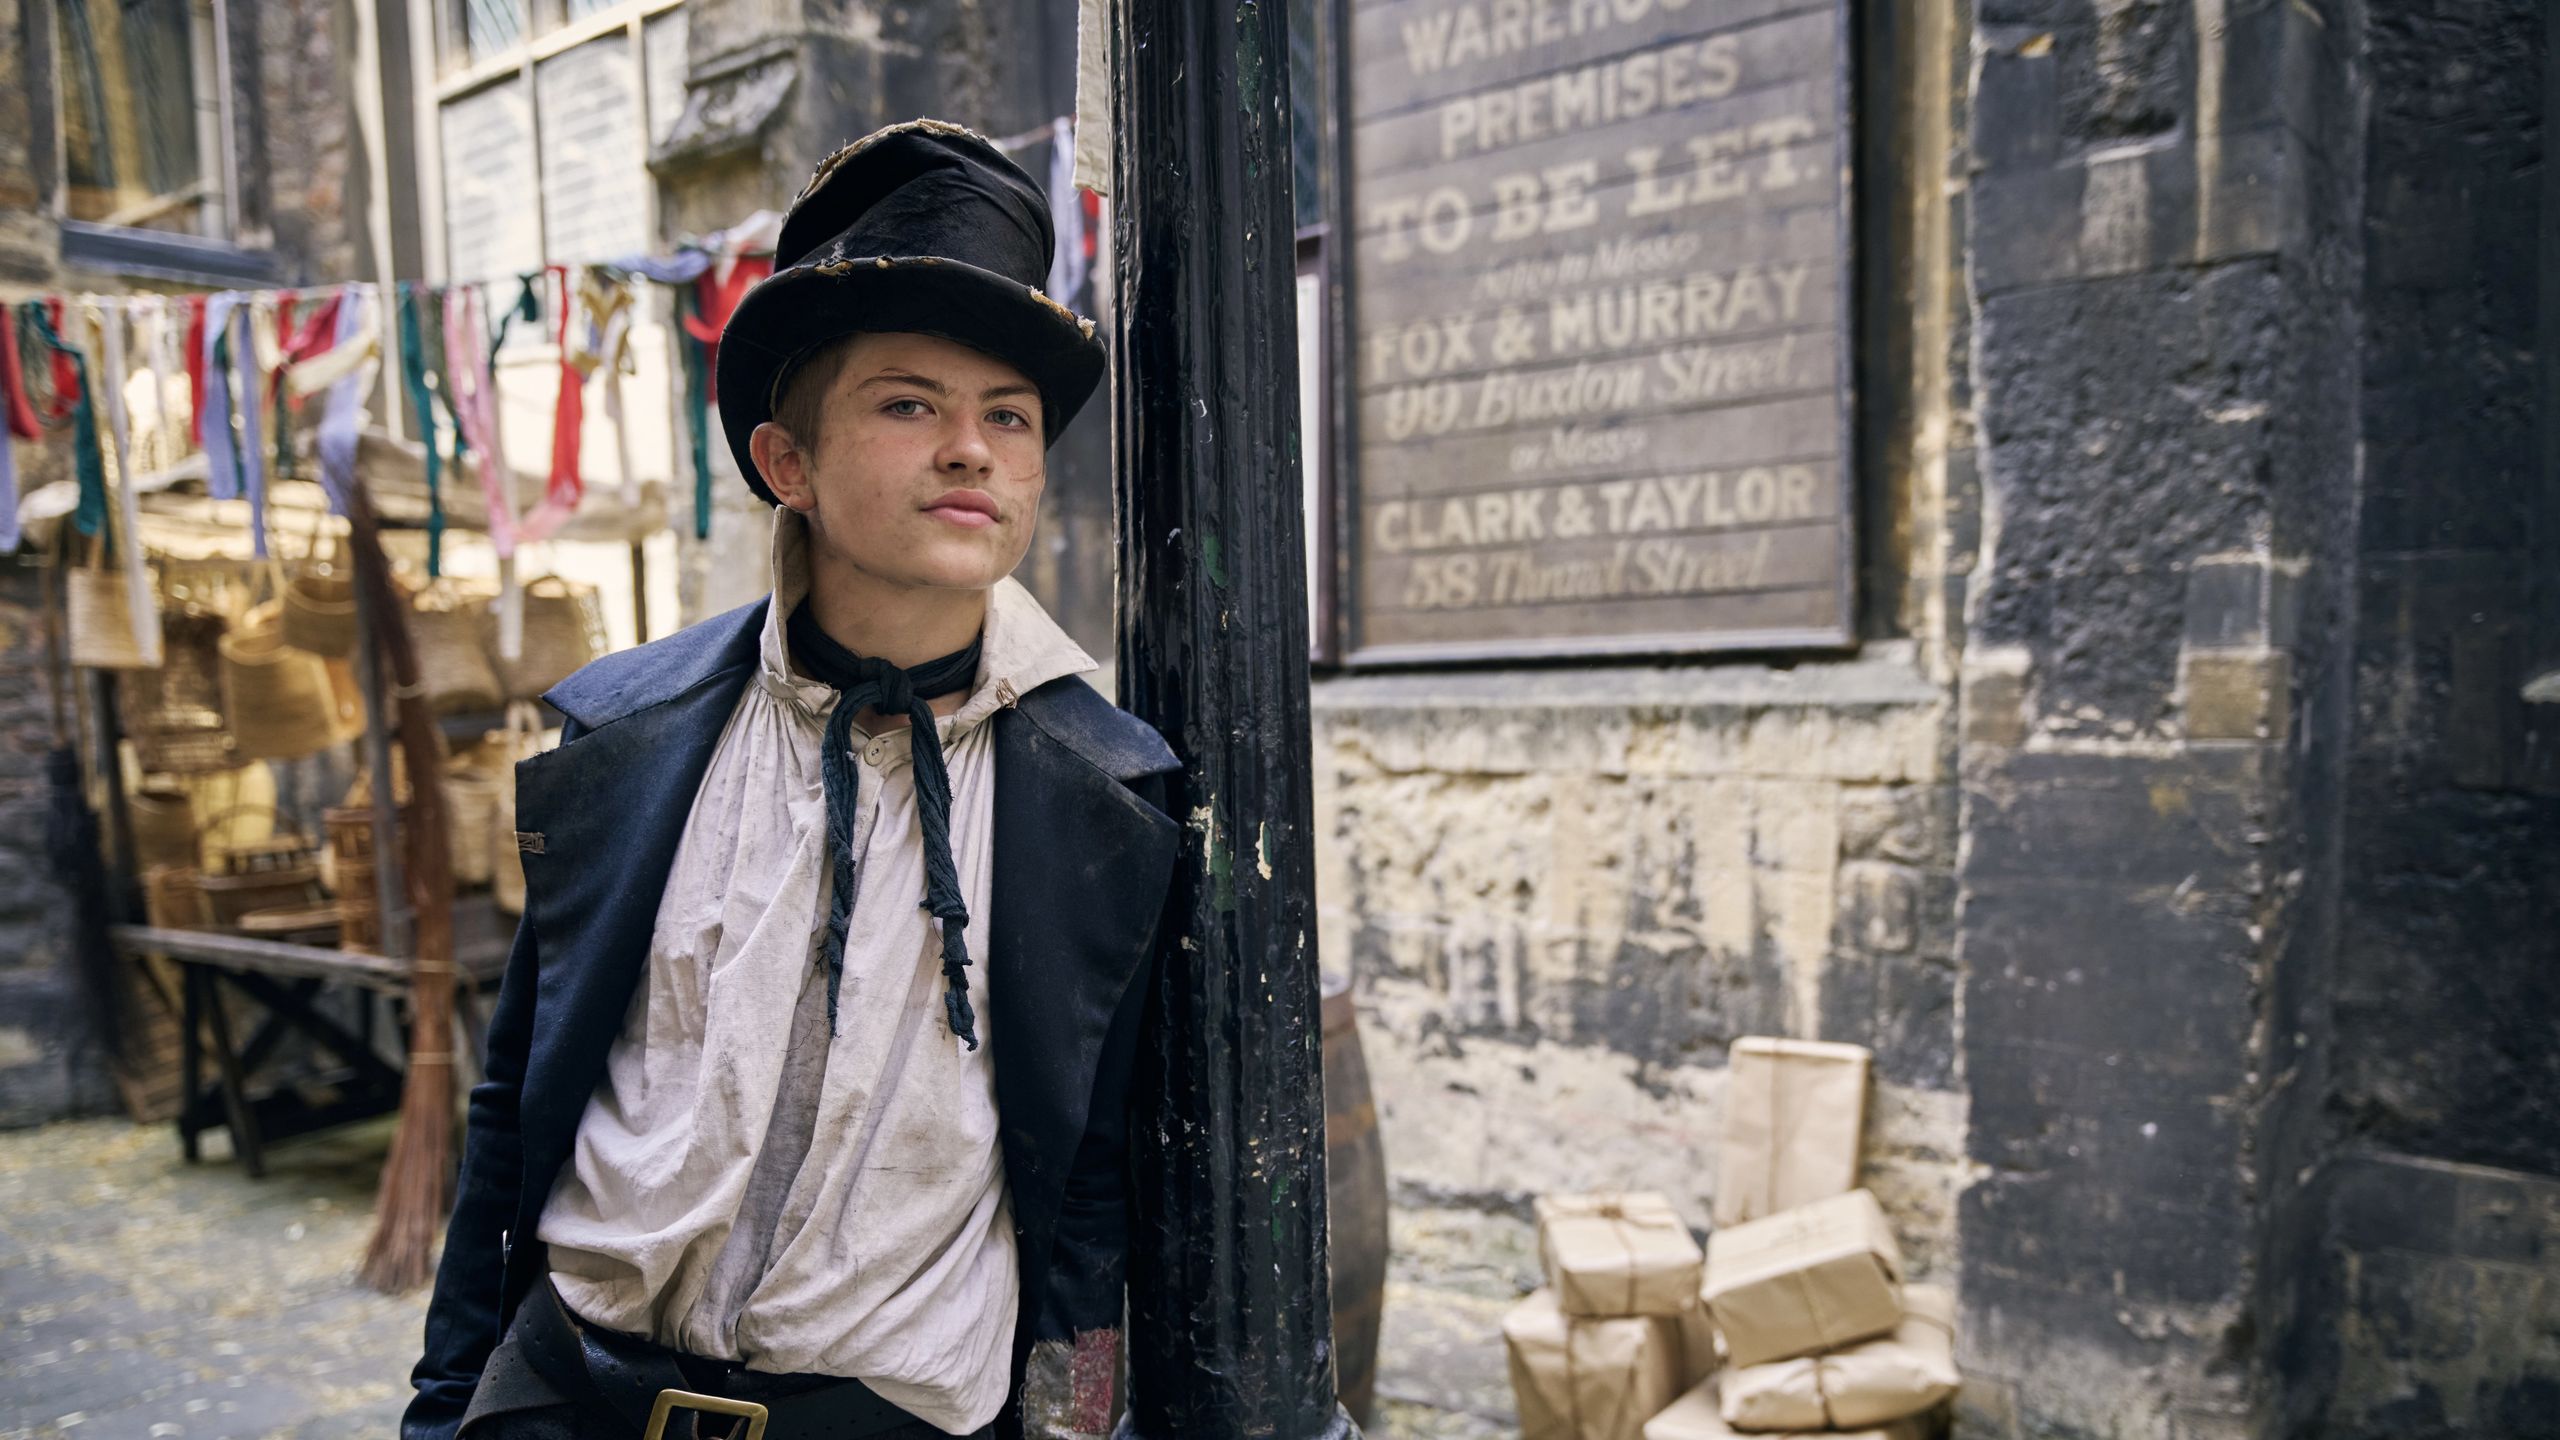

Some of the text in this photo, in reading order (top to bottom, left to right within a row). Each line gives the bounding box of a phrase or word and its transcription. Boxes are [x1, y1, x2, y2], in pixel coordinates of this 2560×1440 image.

[1443, 38, 1740, 161] PREMISES
[1371, 118, 1818, 265] TO BE LET.
[1373, 317, 1475, 384] FOX
[1495, 308, 1534, 364] &
[1552, 265, 1809, 354] MURRAY
[1378, 471, 1814, 554] CLARK & TAYLOR
[1638, 537, 1770, 596] Street
